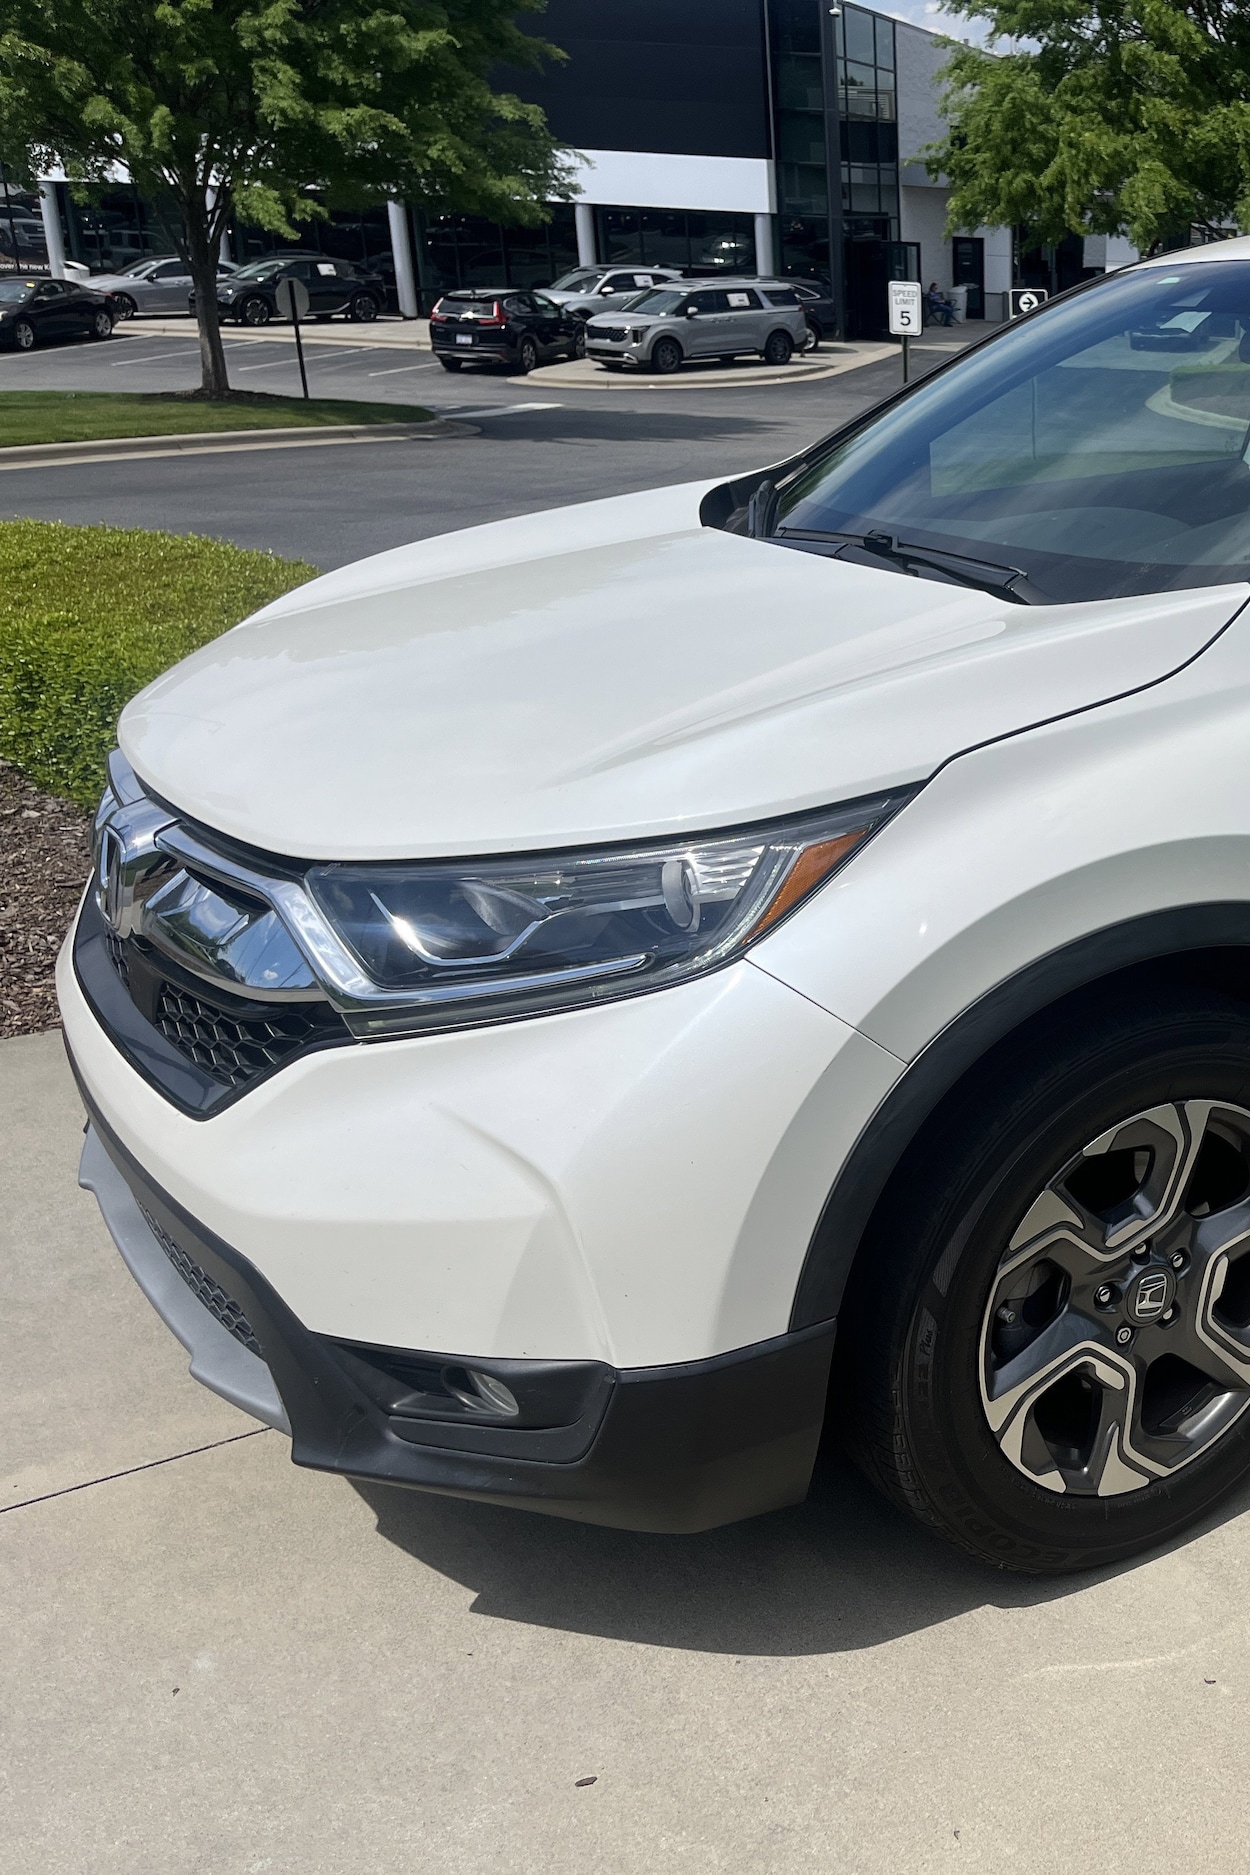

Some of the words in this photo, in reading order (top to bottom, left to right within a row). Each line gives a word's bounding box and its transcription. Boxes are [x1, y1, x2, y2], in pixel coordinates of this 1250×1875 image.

[892, 289, 918, 298] SPEED
[895, 298, 916, 306] LIMIT
[900, 311, 911, 326] 5
[920, 1328, 934, 1357] Plus
